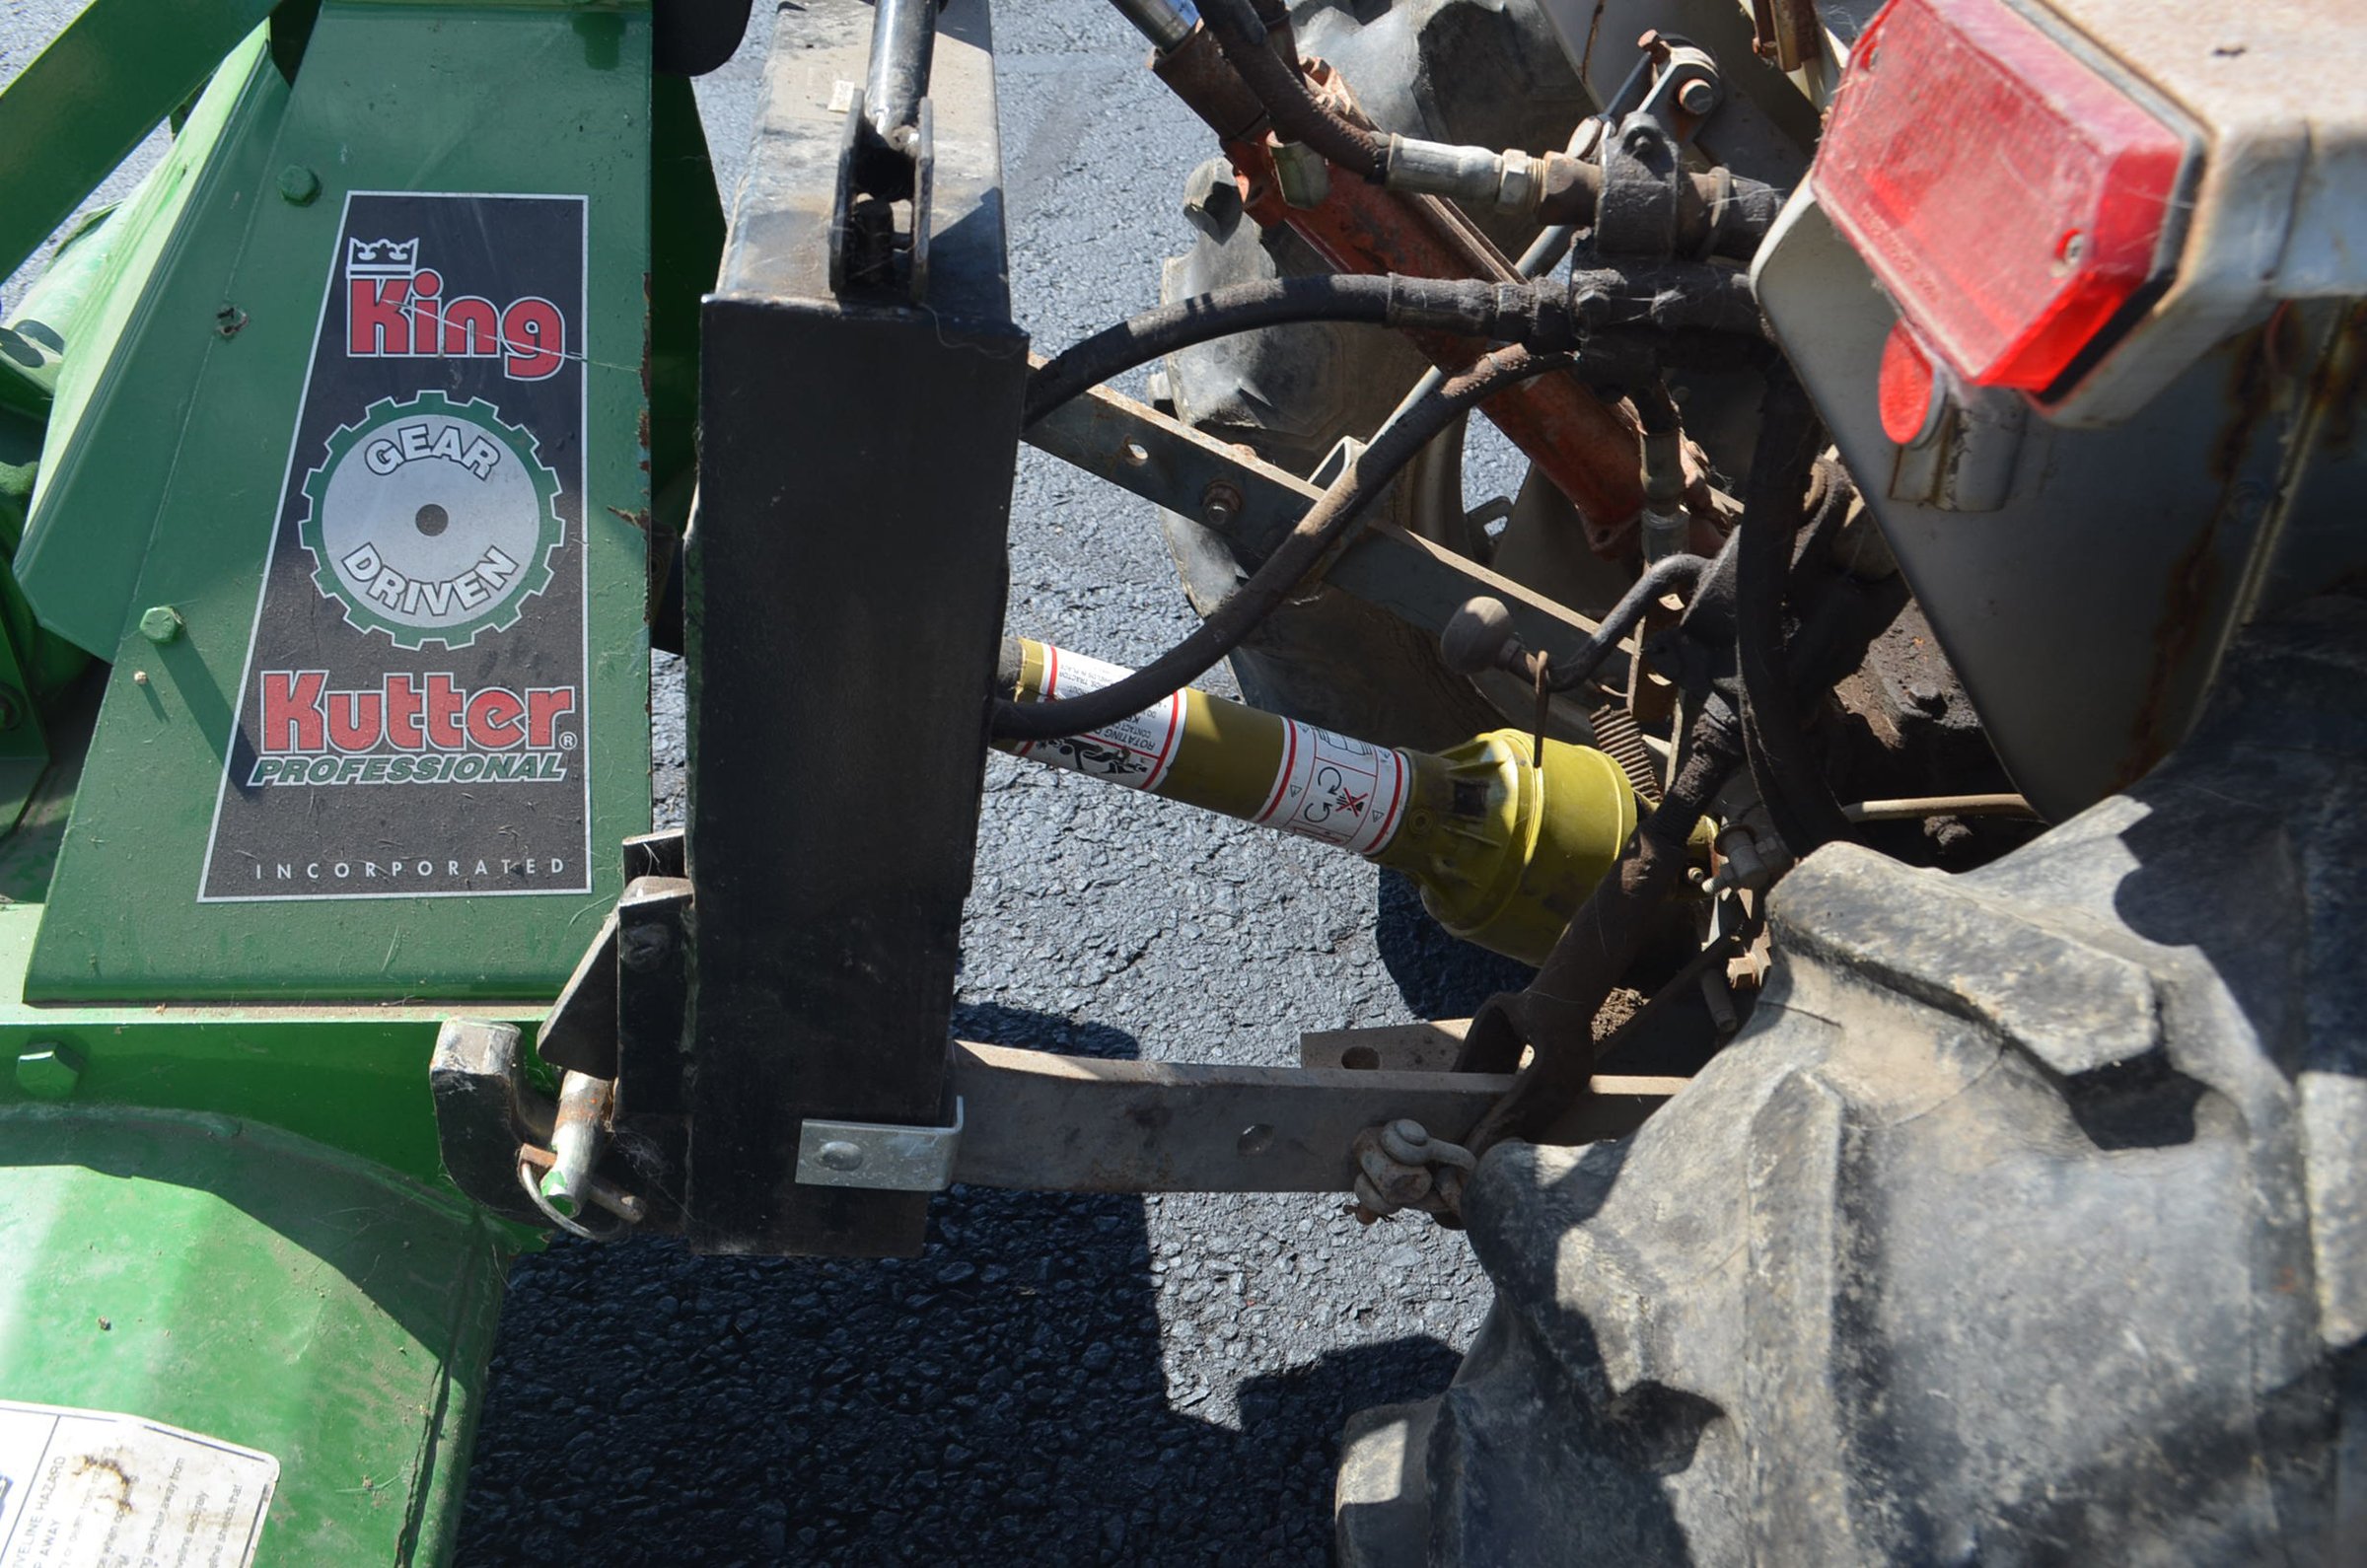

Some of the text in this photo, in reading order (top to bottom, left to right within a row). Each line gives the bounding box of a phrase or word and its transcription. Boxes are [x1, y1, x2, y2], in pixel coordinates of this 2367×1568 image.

[347, 268, 565, 381] King
[364, 424, 500, 480] GEAR
[341, 542, 519, 616] DRIVEN
[260, 670, 576, 755] Kutter
[1120, 723, 1152, 739] CONTACT
[1104, 728, 1156, 750] ROTATING
[247, 751, 566, 787] PROFESSIONAL
[255, 858, 565, 880] INCORPORATED
[36, 1456, 66, 1511] HAZARD
[161, 1481, 179, 1510] away
[170, 1457, 184, 1480] from
[228, 1483, 243, 1505] that
[39, 1519, 60, 1557] AWAY
